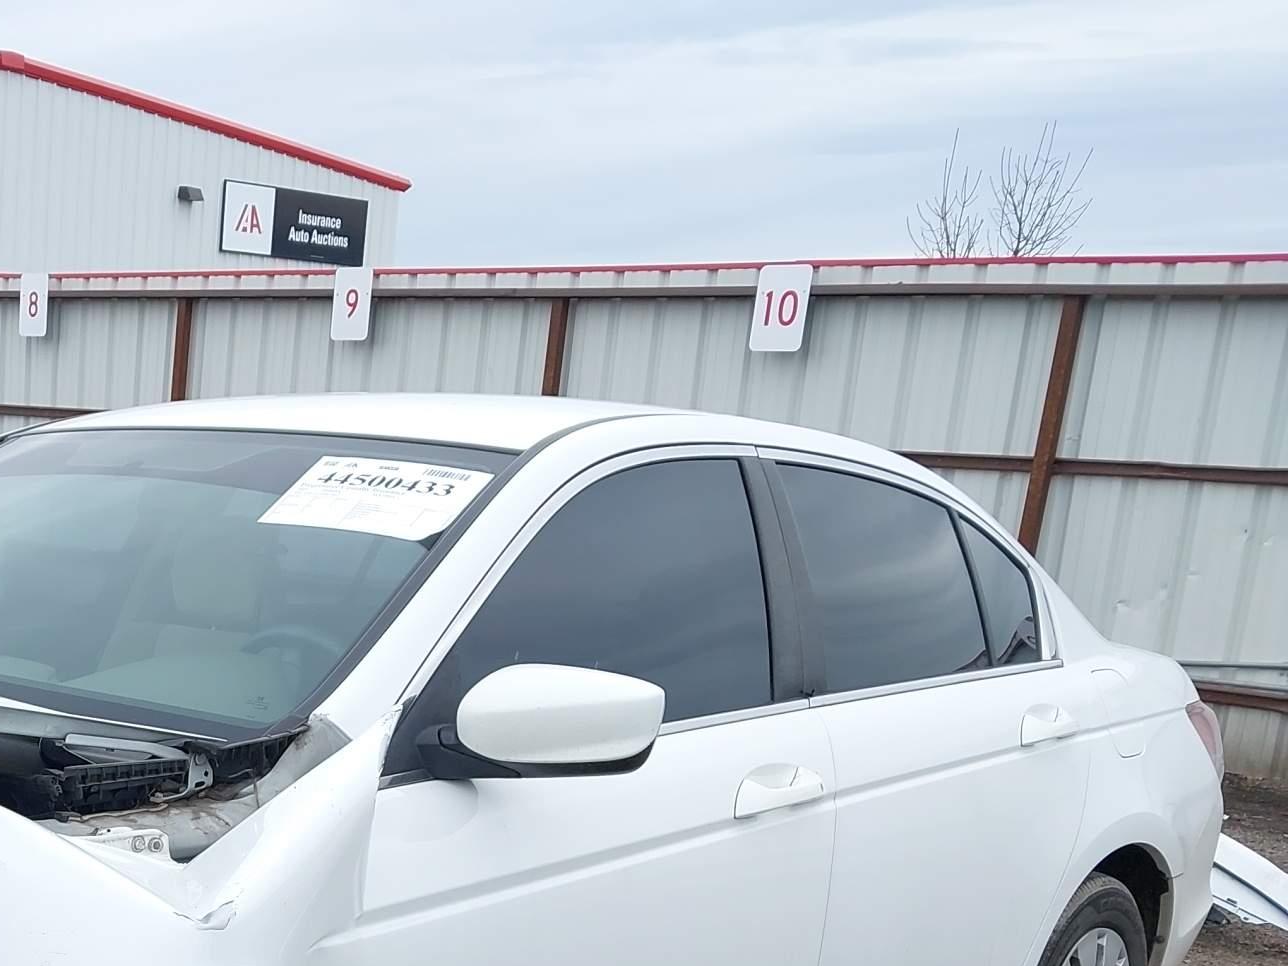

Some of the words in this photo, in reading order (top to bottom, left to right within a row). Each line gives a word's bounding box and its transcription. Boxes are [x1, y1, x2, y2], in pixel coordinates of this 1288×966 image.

[299, 209, 341, 229] Insurance
[288, 226, 309, 243] Auto
[310, 229, 349, 248] Auctions
[29, 291, 39, 317] 8
[346, 290, 359, 318] 9
[763, 290, 799, 326] 10
[318, 471, 455, 497] 44500433
